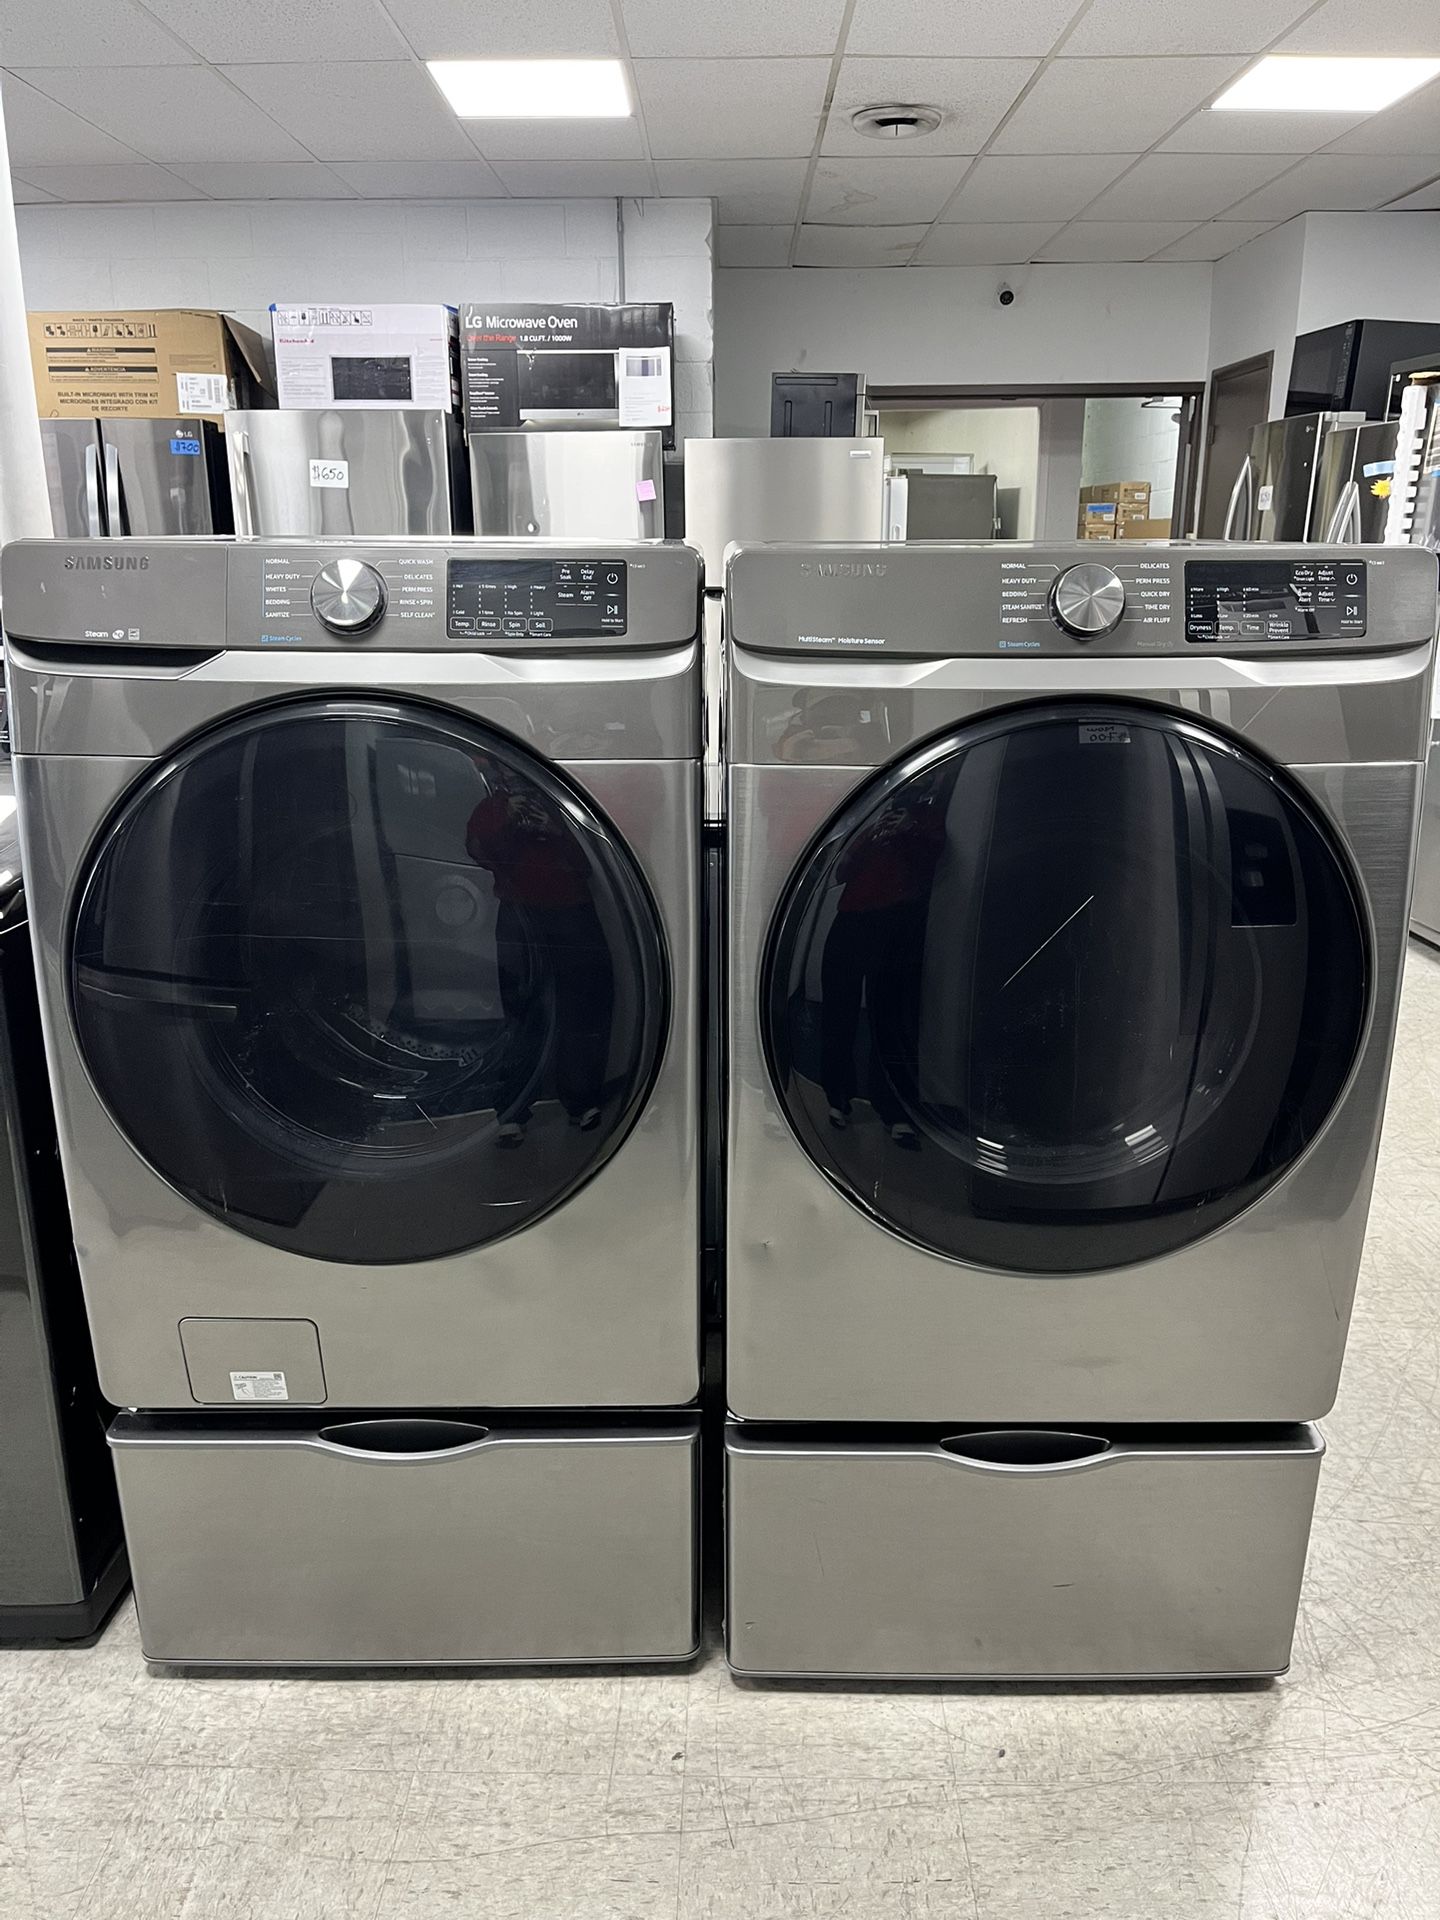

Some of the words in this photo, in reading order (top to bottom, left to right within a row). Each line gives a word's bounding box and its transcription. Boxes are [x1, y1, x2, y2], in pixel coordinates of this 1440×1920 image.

[465, 316, 482, 329] LG
[486, 315, 546, 329] Microwave
[547, 315, 578, 329] Oven
[496, 335, 517, 343] Range
[312, 465, 344, 480] $650
[64, 555, 149, 570] SAMSUNG
[1140, 590, 1158, 598] QUICK
[1189, 625, 1212, 633] Dryness
[85, 630, 109, 638] Steam
[285, 634, 302, 642] Cycles
